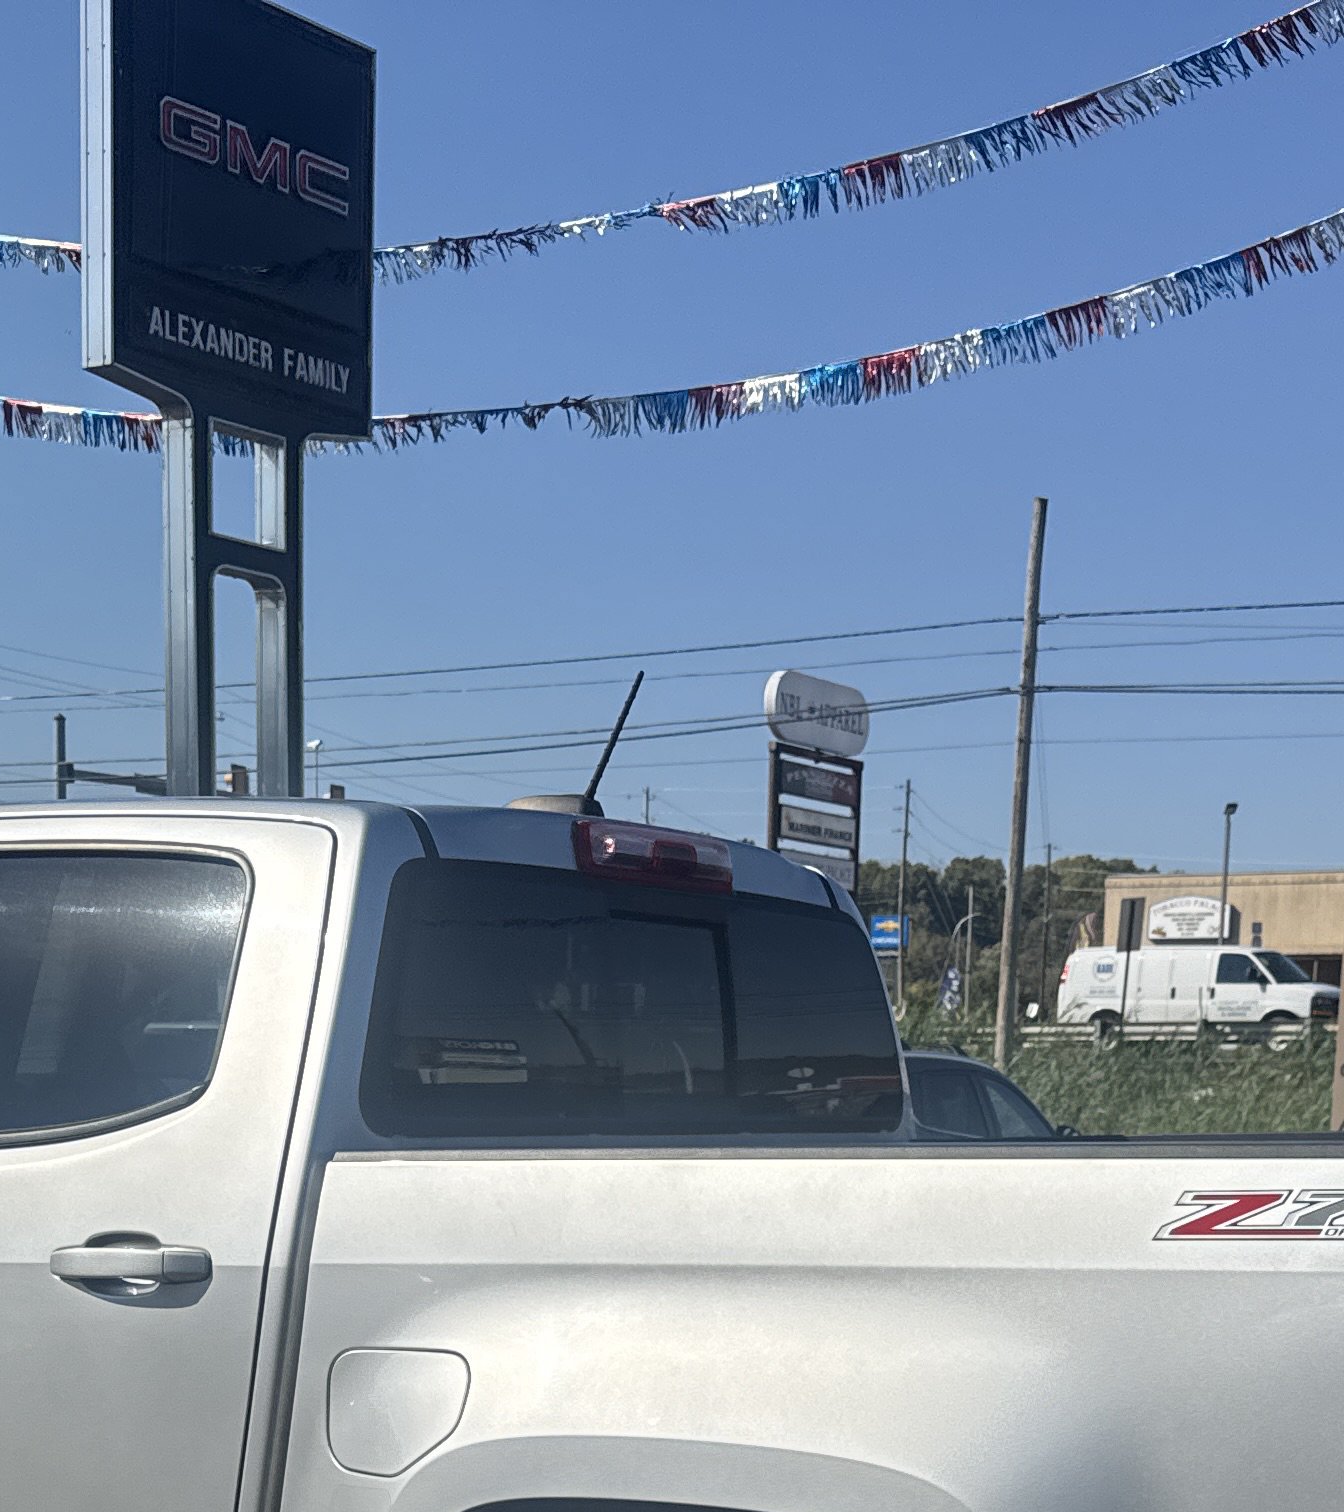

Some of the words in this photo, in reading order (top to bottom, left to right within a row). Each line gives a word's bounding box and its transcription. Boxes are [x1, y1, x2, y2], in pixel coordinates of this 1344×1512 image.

[159, 95, 350, 217] GMC
[149, 306, 273, 373] ALEXANDER
[283, 348, 351, 394] FAMILY
